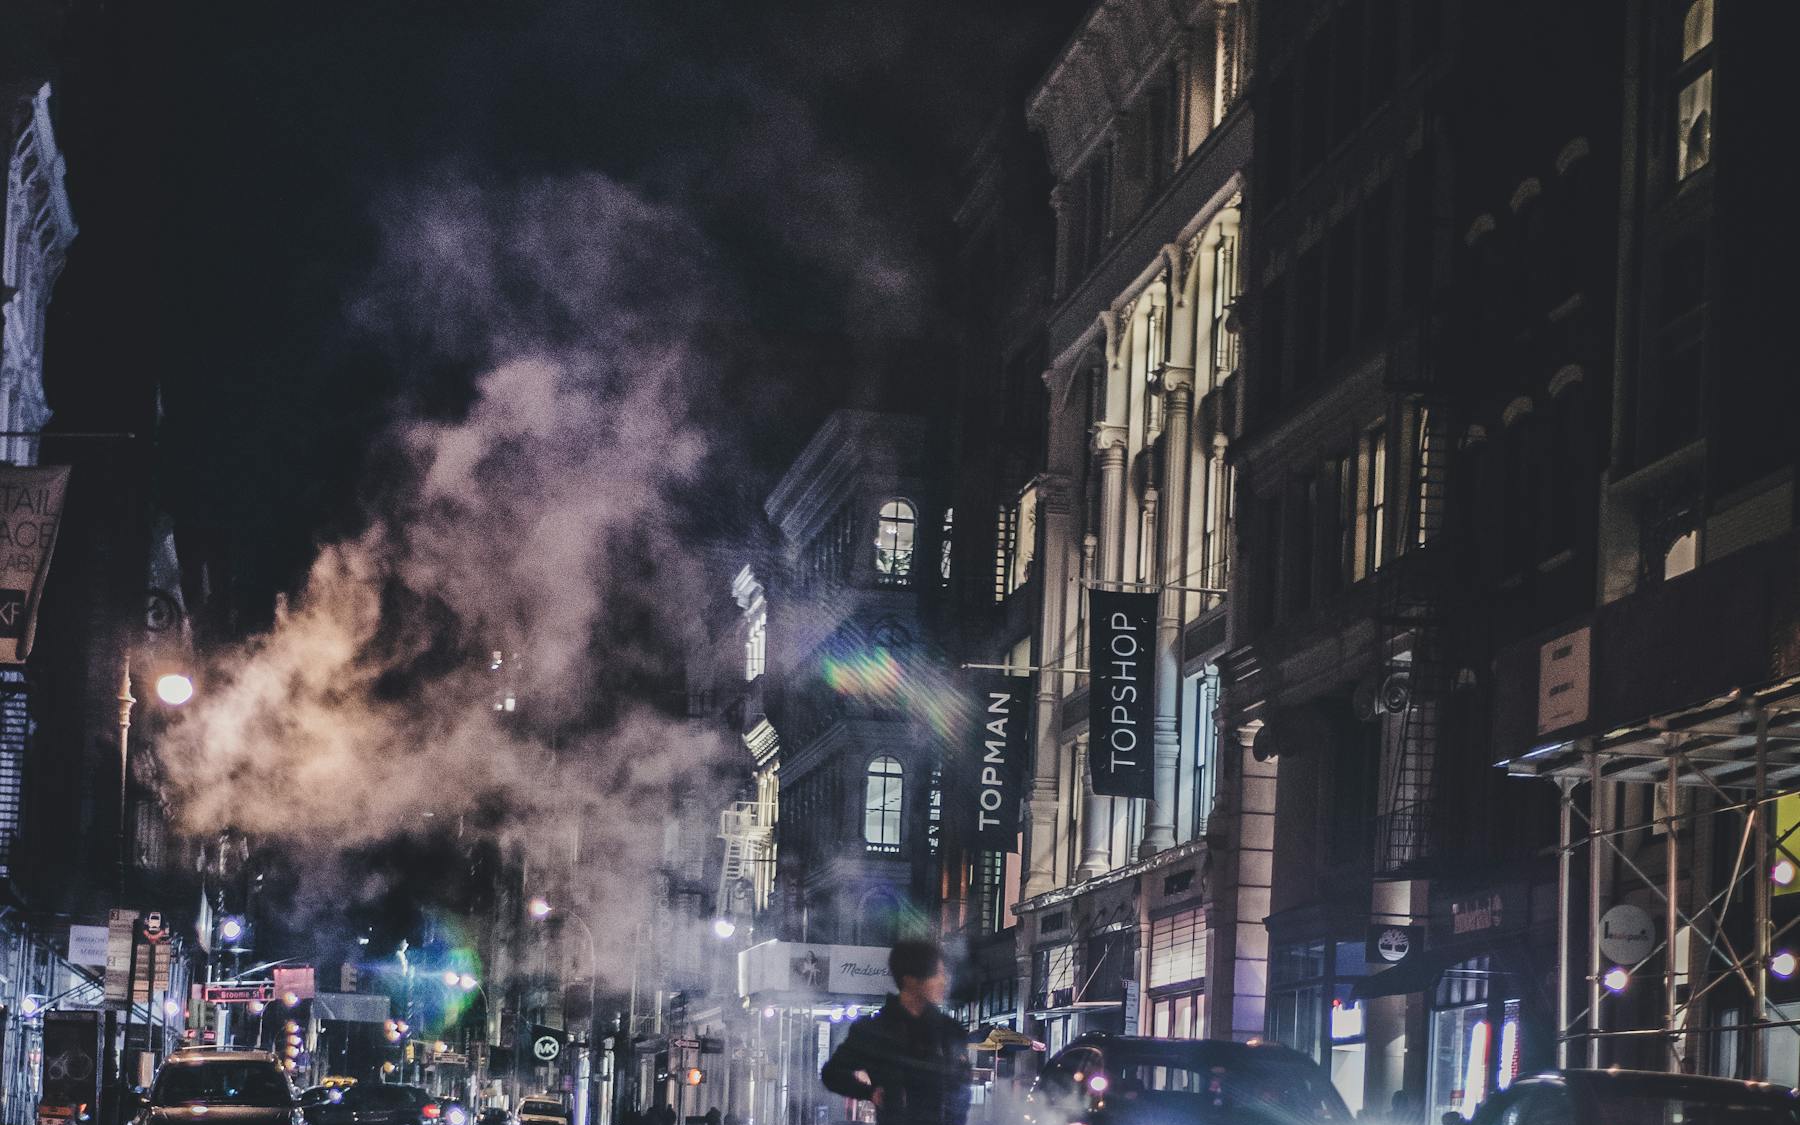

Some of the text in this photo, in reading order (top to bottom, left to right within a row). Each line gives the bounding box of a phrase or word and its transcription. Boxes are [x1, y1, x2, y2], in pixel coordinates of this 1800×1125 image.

[978, 692, 1011, 831] TOPMAN
[1110, 612, 1137, 773] TOPSHOP
[221, 990, 261, 999] Broome St
